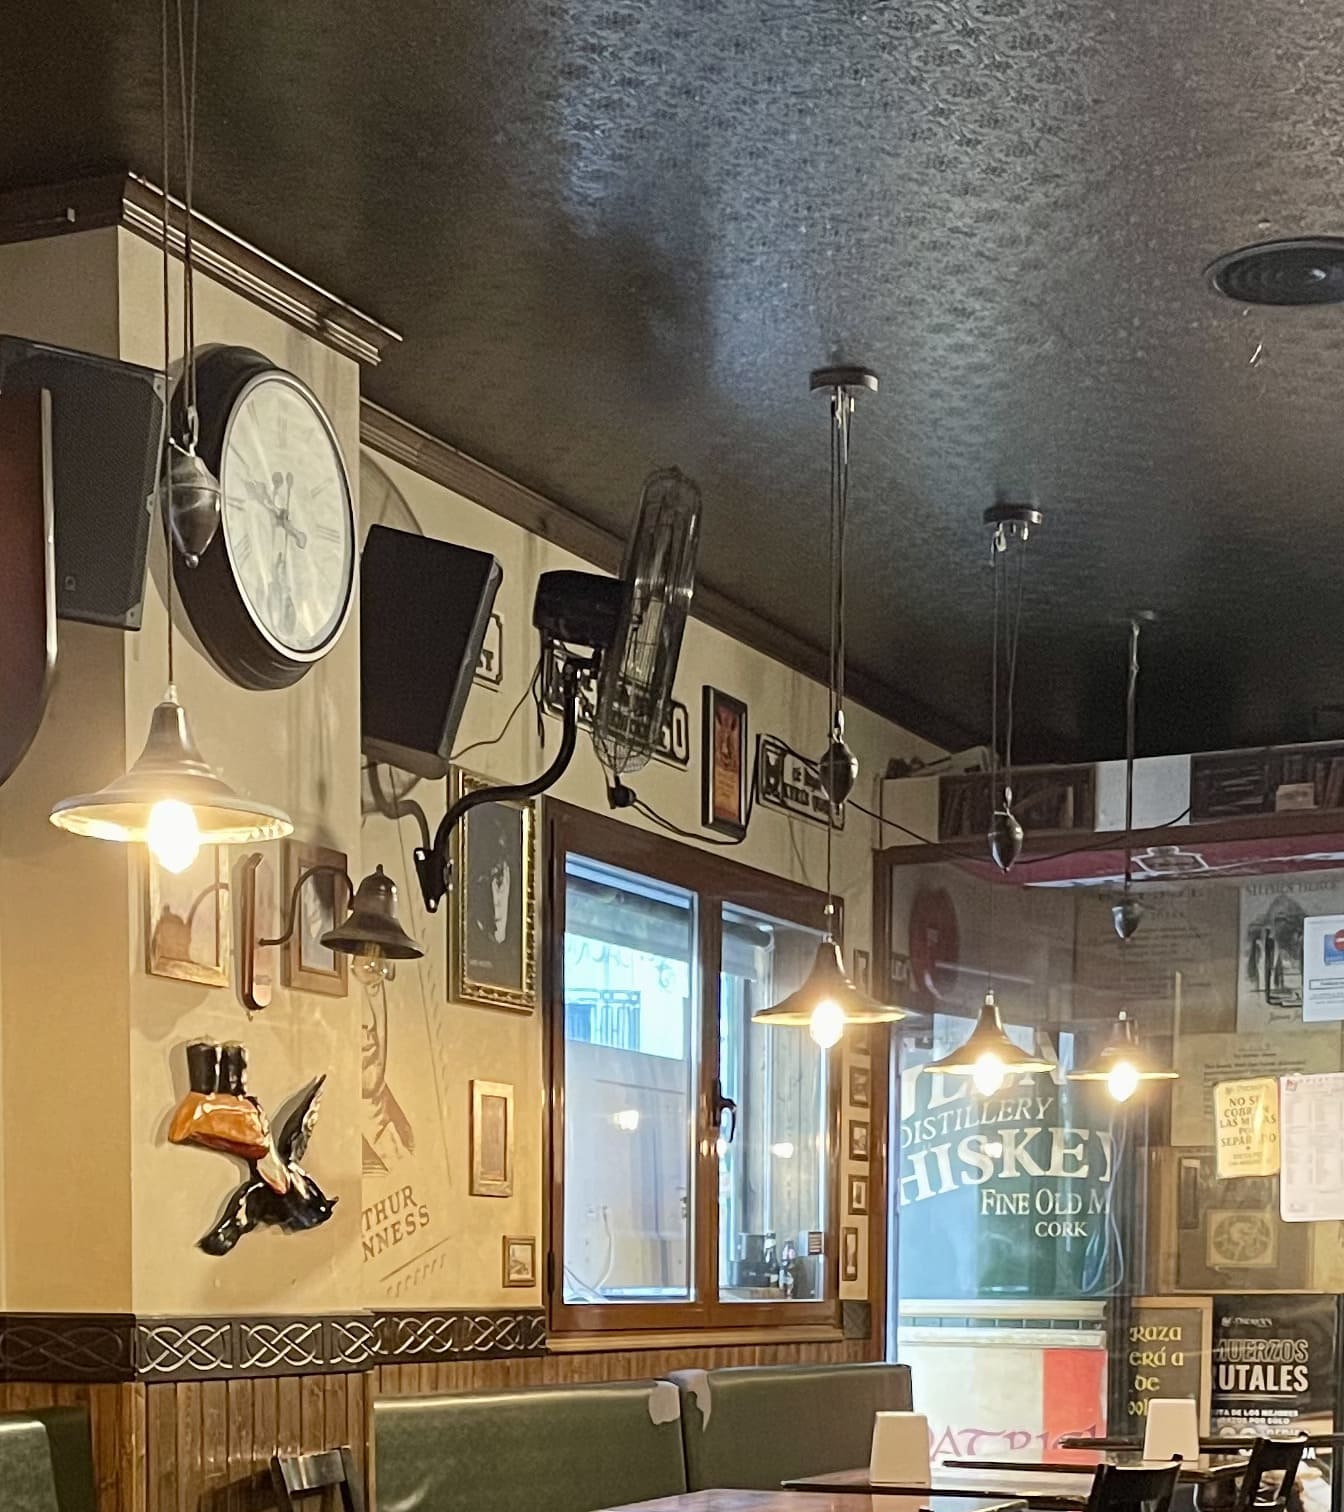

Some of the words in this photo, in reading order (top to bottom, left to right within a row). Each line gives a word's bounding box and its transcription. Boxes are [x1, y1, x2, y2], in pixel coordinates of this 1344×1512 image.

[901, 1097, 1054, 1149] DISTILLERY
[1224, 1106, 1270, 1119] COBRN
[1240, 1114, 1277, 1127] MAS
[1221, 1134, 1277, 1147] SEPARO
[361, 1185, 418, 1231] THUR
[981, 1188, 1030, 1216] FINE
[1035, 1188, 1083, 1216] OLD
[361, 1204, 430, 1263] NNESS
[1035, 1221, 1088, 1238] CORK
[1213, 1364, 1309, 1392] UTALES
